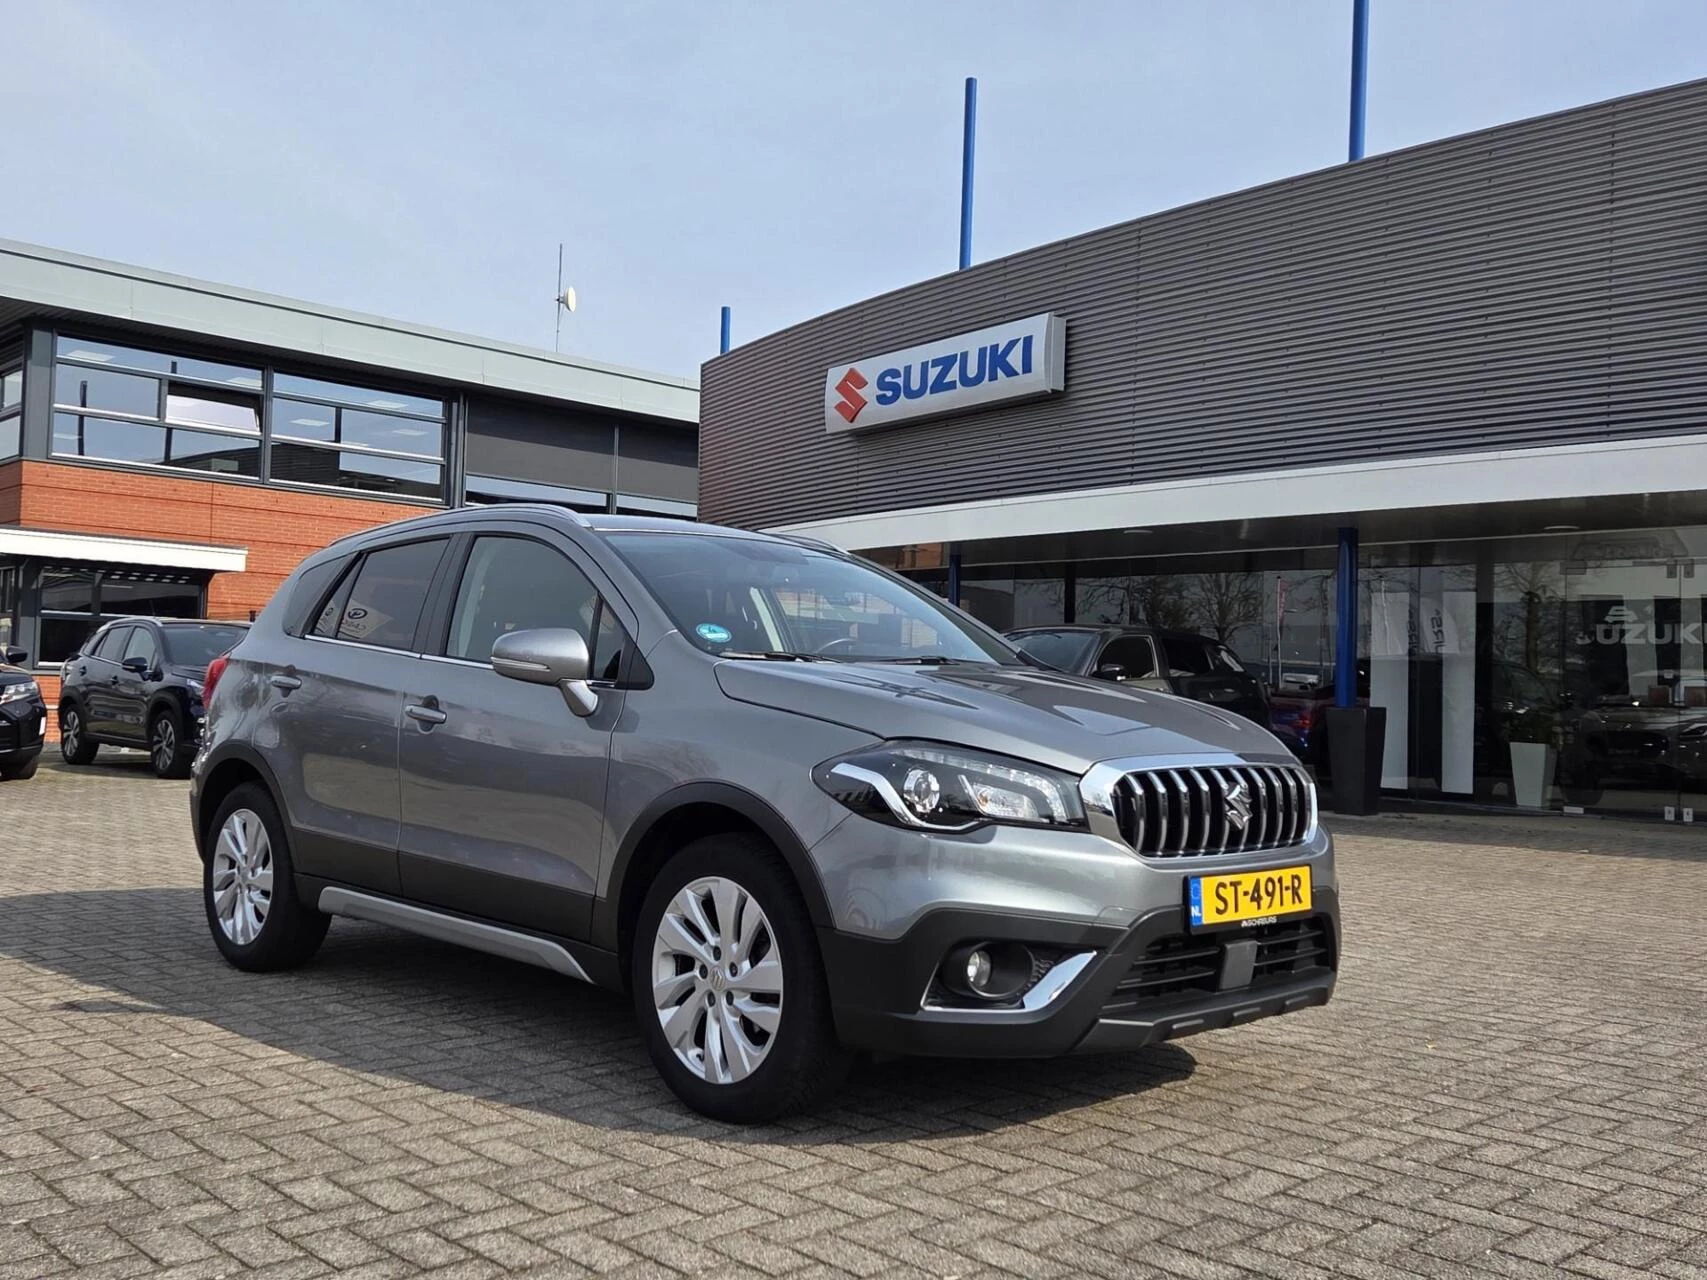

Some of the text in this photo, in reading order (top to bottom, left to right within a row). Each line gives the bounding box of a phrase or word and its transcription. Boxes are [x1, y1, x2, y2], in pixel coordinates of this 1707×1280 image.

[875, 334, 1034, 406] SUZUKI
[1190, 905, 1202, 917] NL
[1215, 874, 1303, 916] ST-491-R
